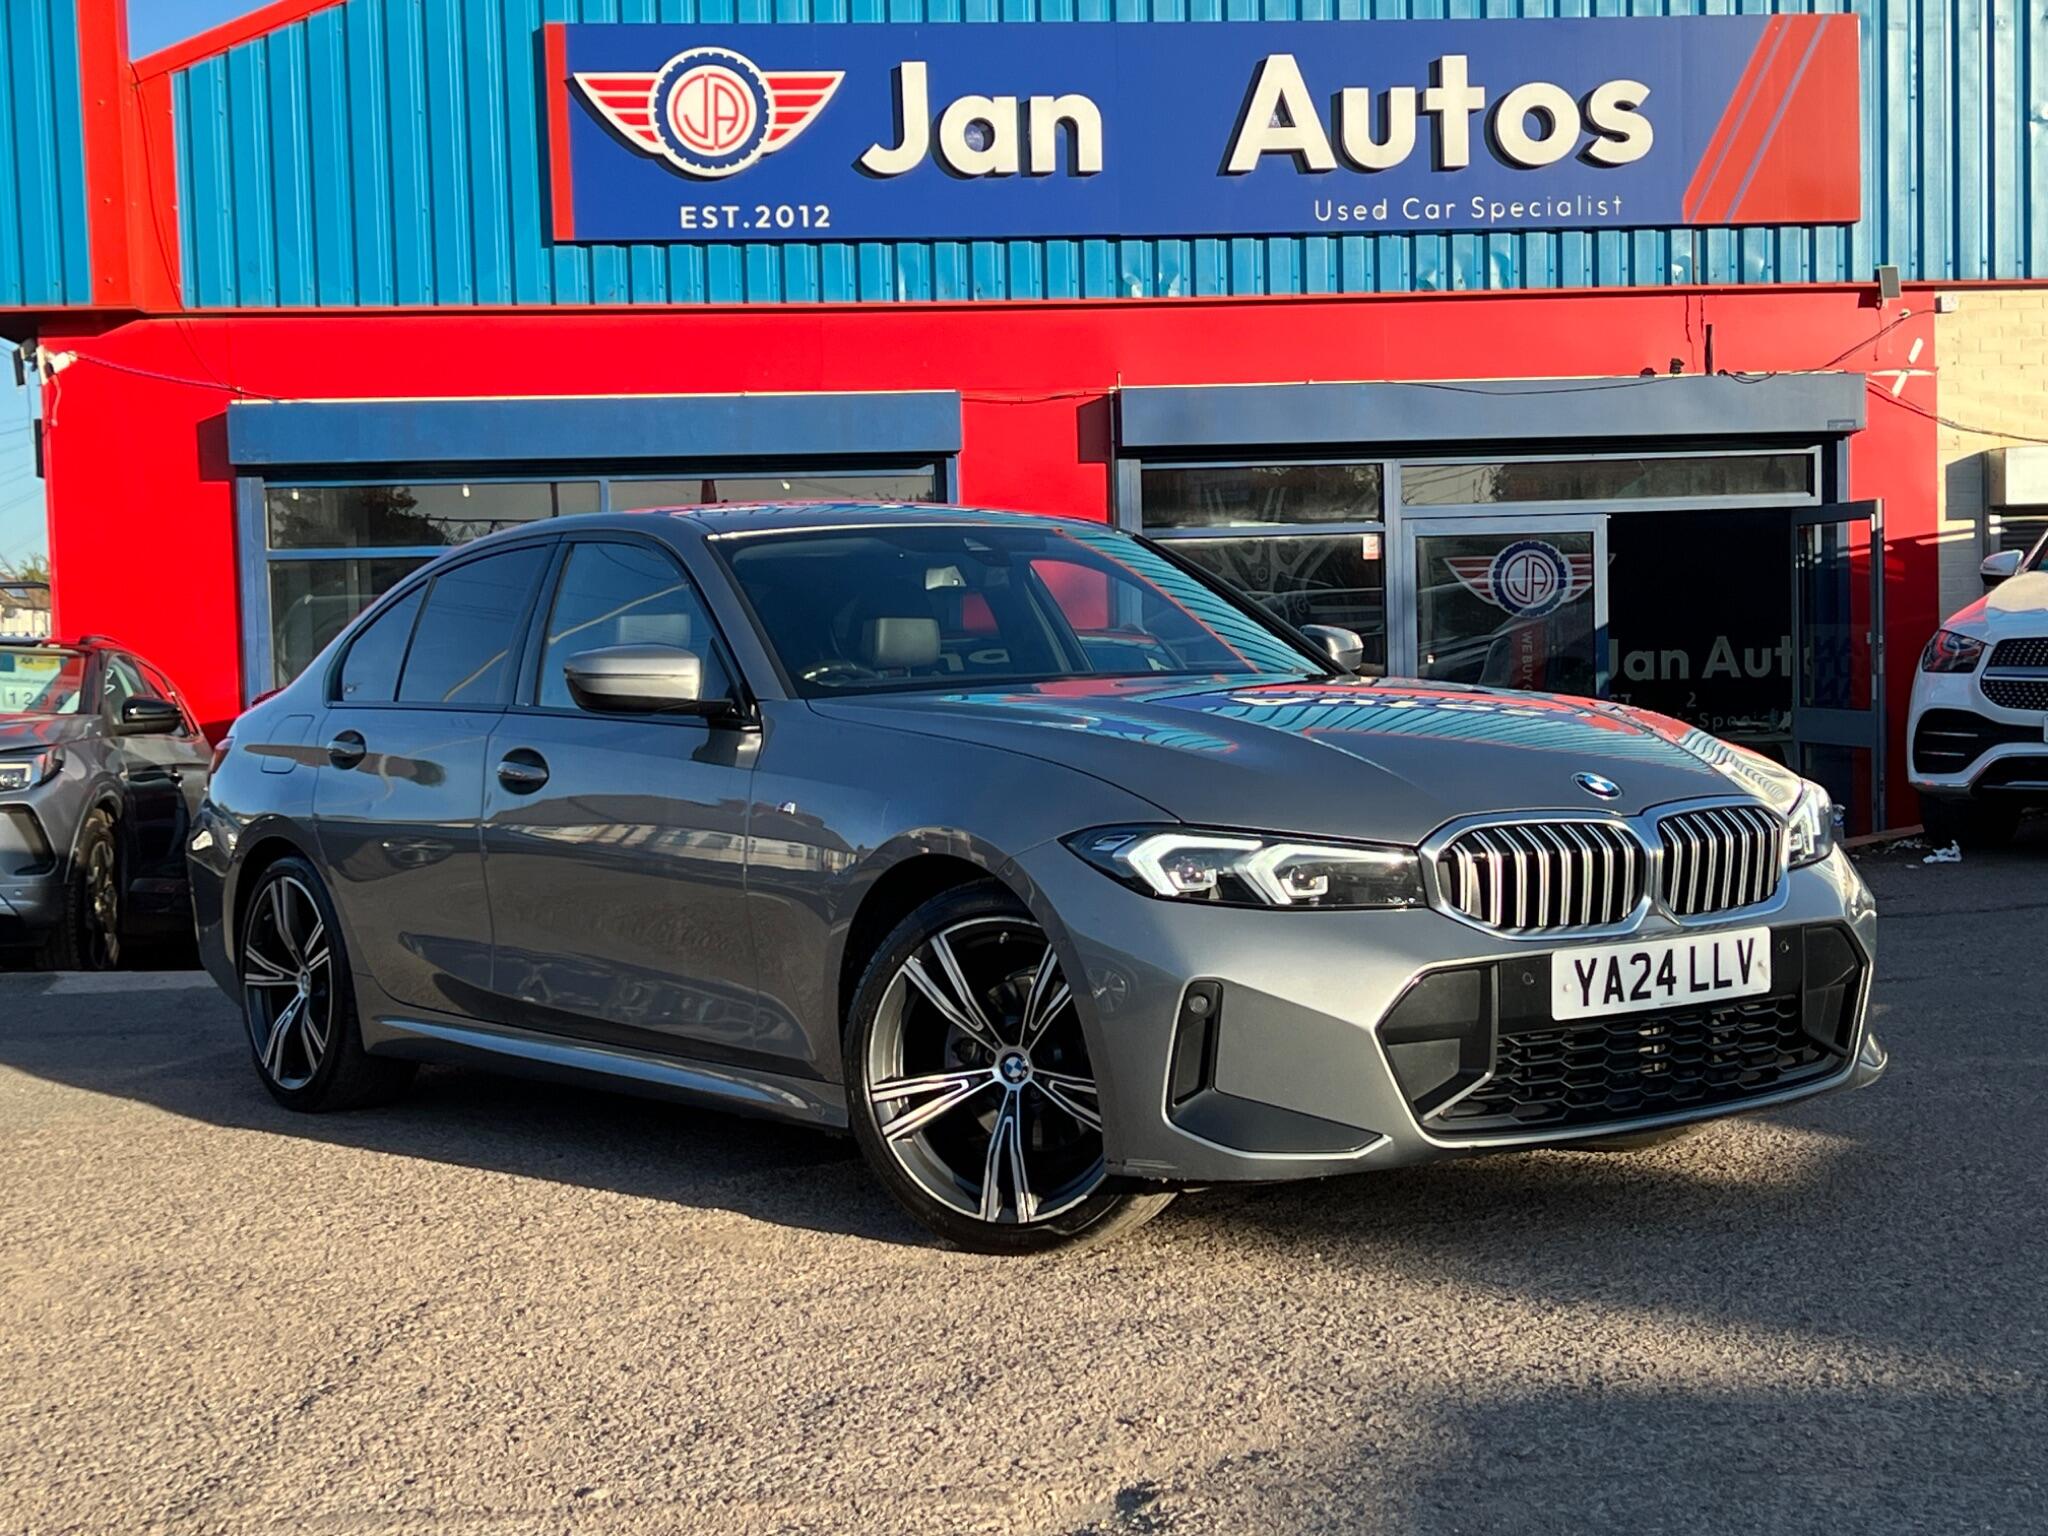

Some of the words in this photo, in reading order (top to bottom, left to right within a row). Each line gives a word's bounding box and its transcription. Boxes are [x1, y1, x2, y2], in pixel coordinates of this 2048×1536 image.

[861, 61, 1103, 175] Jan
[1228, 54, 1654, 172] Autos
[680, 205, 830, 229] EST.2012
[1314, 199, 1387, 221] Used
[1402, 198, 1455, 220] Car
[1471, 195, 1622, 223] Specialist
[1521, 630, 1533, 653] WE
[1521, 656, 1533, 682] BUY
[1608, 638, 1690, 681] Jan
[1574, 949, 1677, 1007] YA24
[1690, 938, 1754, 993] LLV
